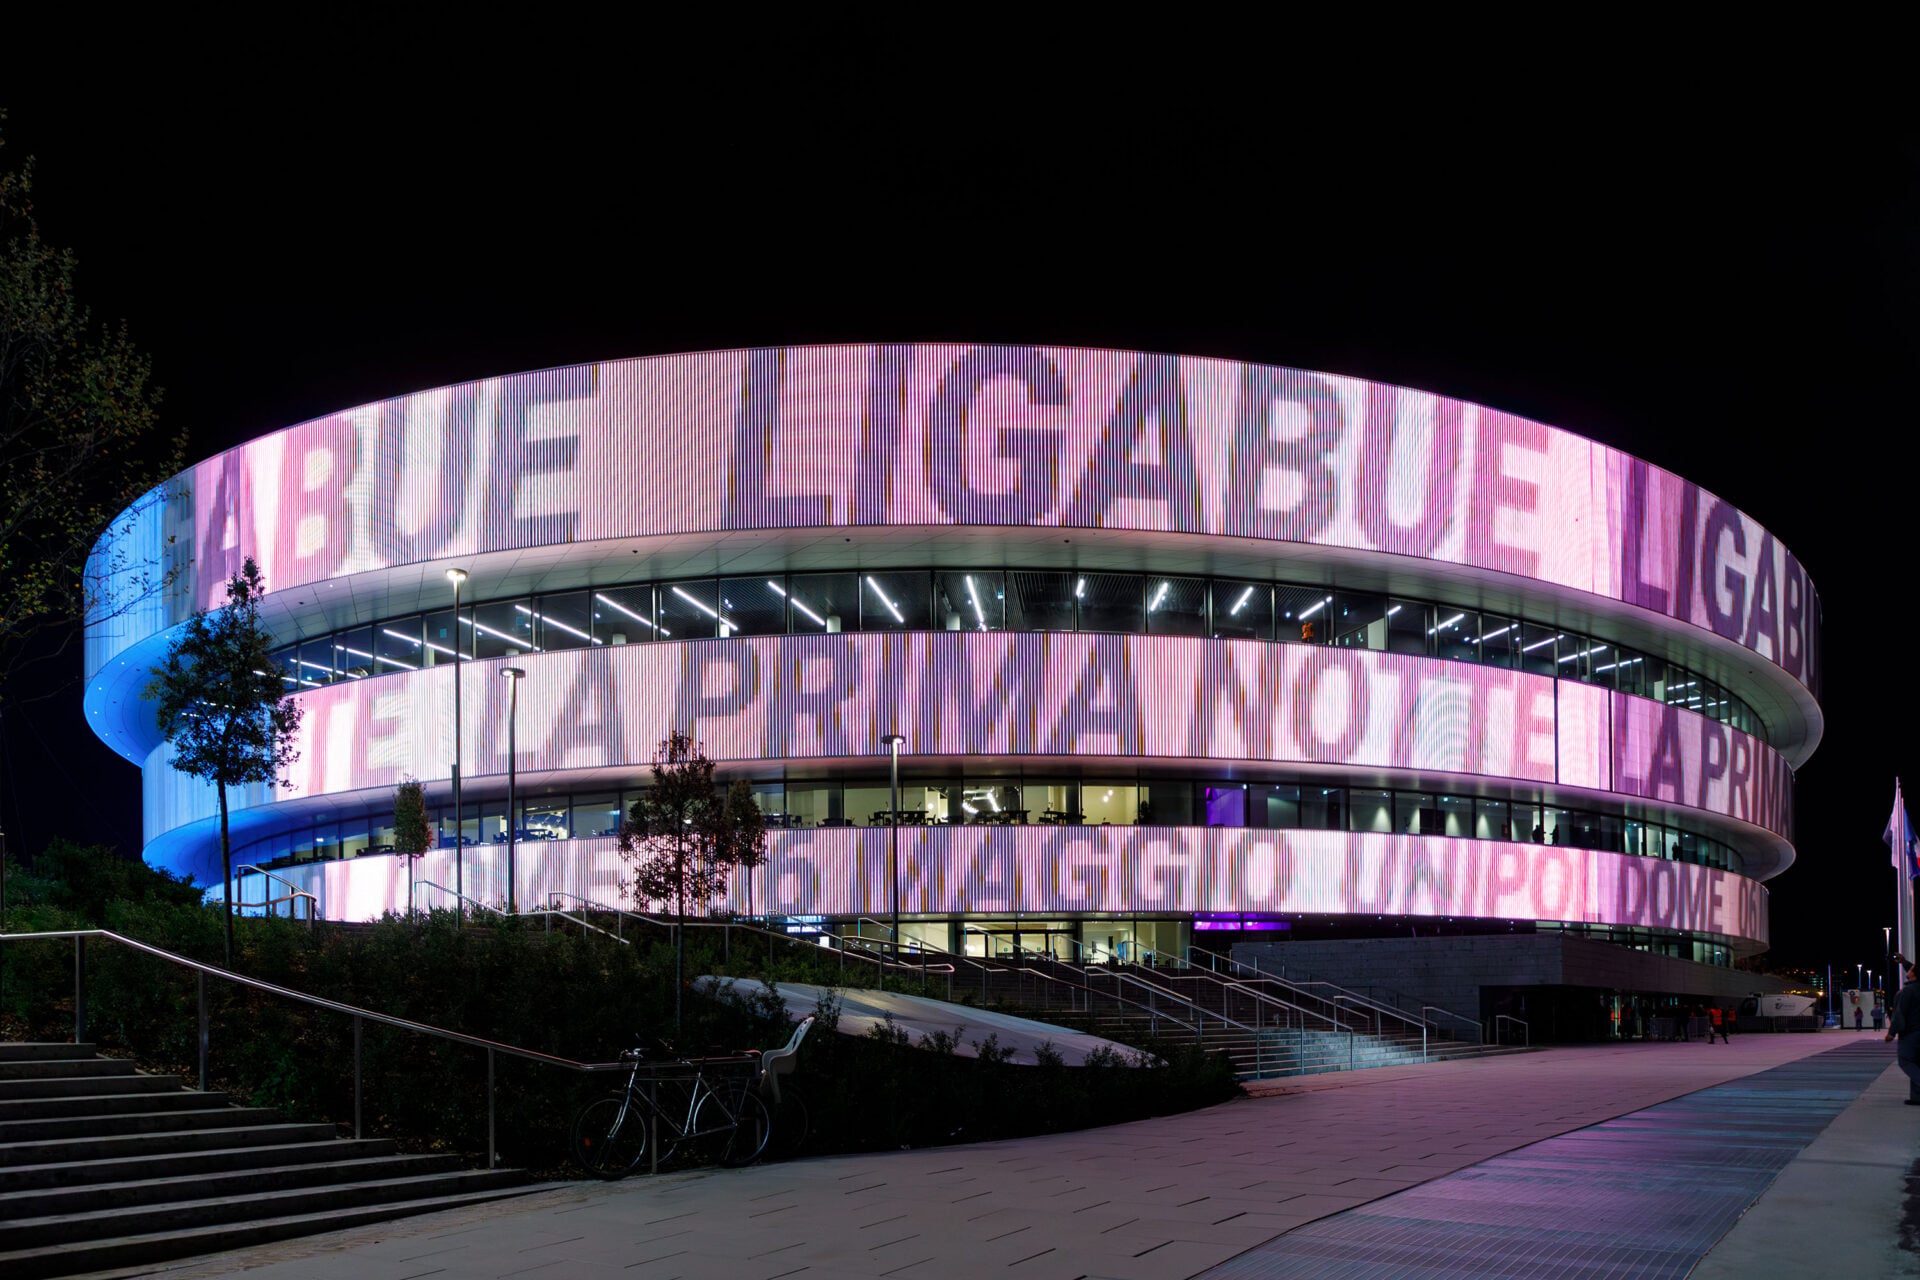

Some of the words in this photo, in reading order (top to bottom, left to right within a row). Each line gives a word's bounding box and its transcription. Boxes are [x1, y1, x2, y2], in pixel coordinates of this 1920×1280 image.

[720, 344, 1549, 575] LIGABUE
[474, 646, 629, 778] LA
[681, 631, 1146, 764] PRIMA
[1188, 636, 1555, 782] NOTTE
[1613, 690, 1685, 805] LA
[857, 825, 1296, 914] MAGGIO
[1341, 832, 1602, 923] UNIPOL
[1616, 852, 1724, 933] DOME
